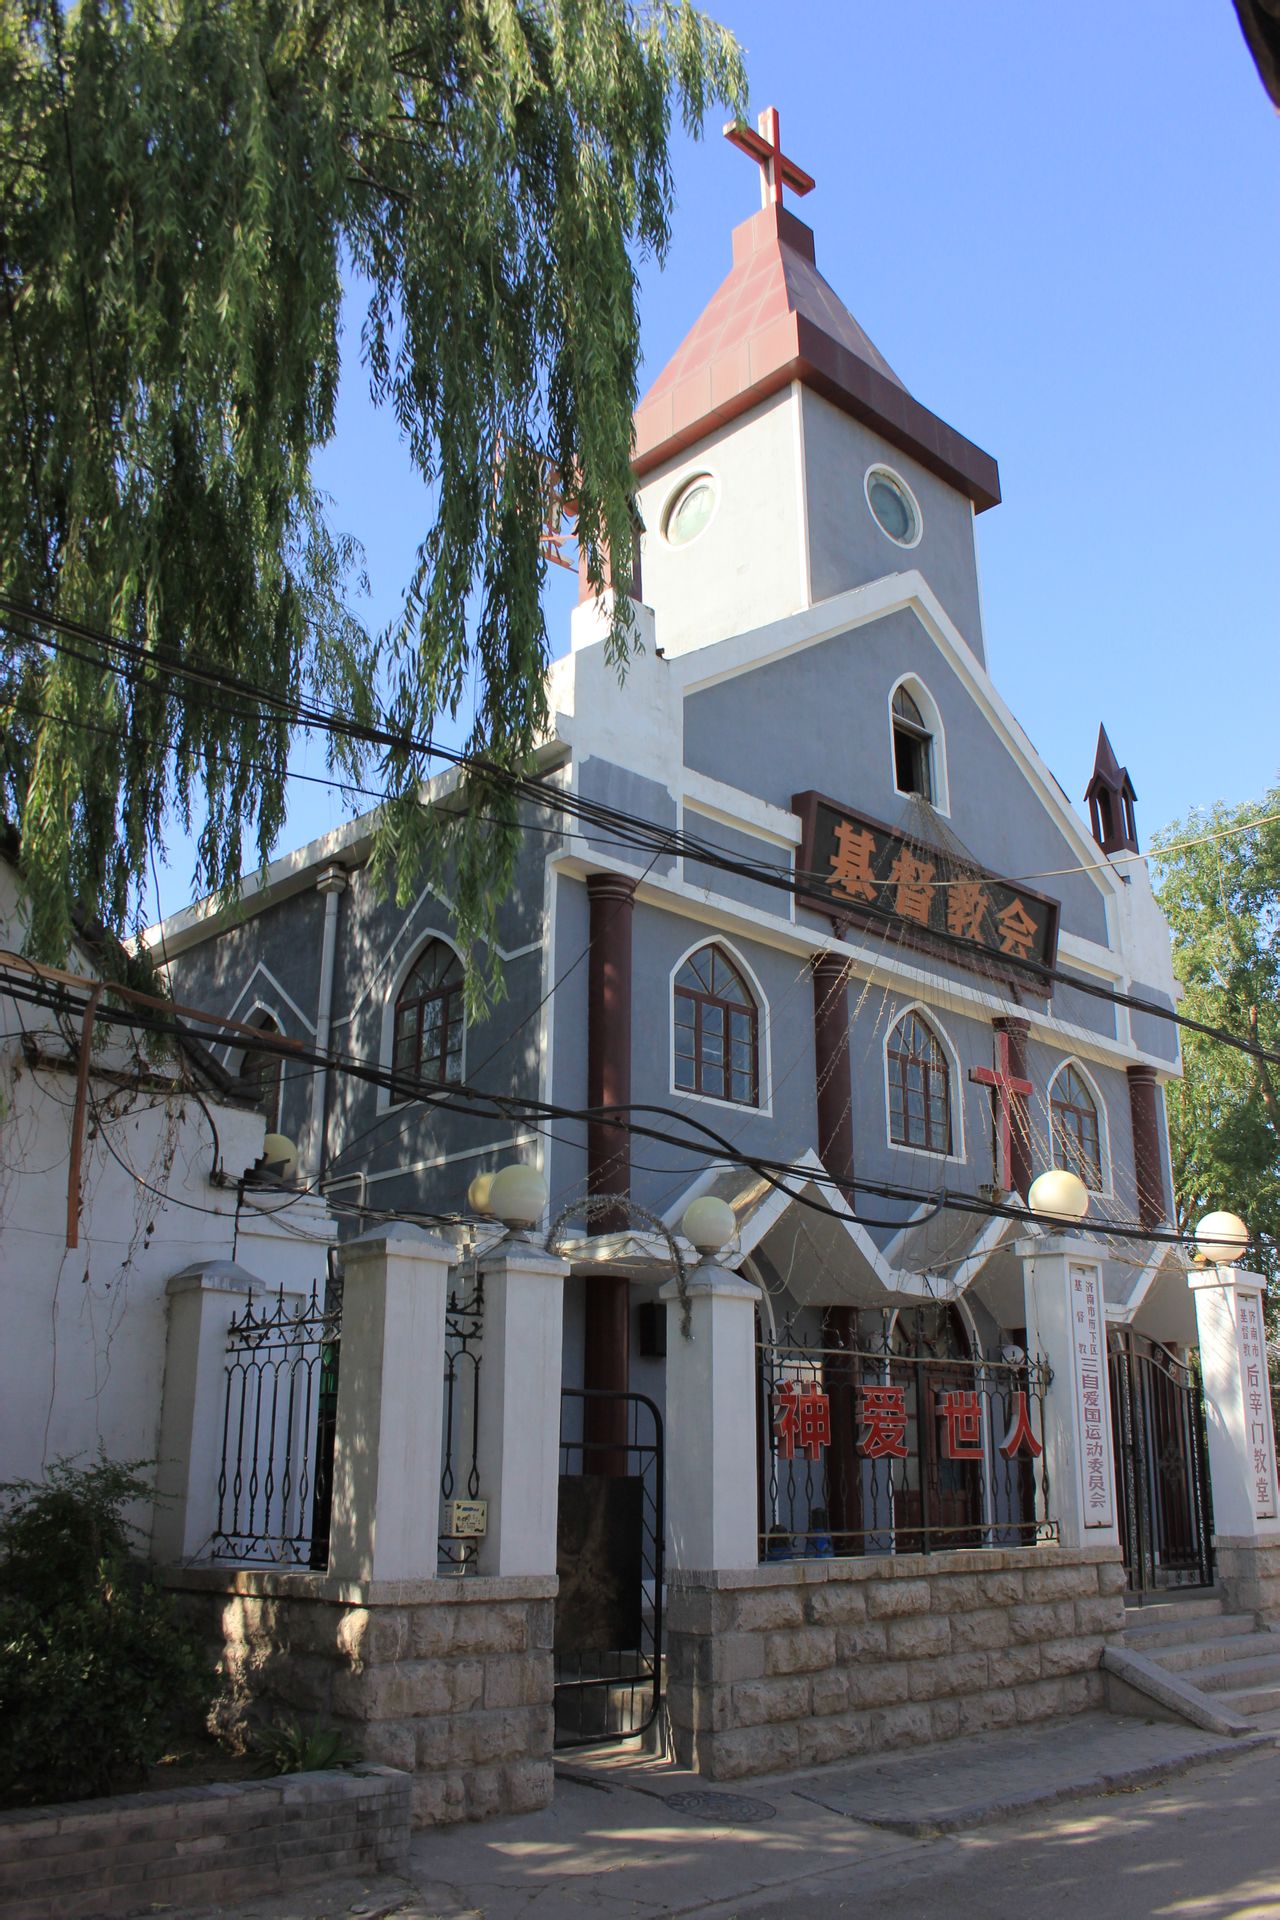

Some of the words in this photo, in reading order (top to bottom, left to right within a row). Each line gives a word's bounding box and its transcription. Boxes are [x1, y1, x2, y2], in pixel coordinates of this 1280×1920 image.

[825, 820, 1038, 960] 基督教会
[771, 1379, 1042, 1461] 神爱世人
[1081, 1357, 1106, 1509] 三自爱国运动委员会
[1246, 1363, 1270, 1503] 后宰门教堂
